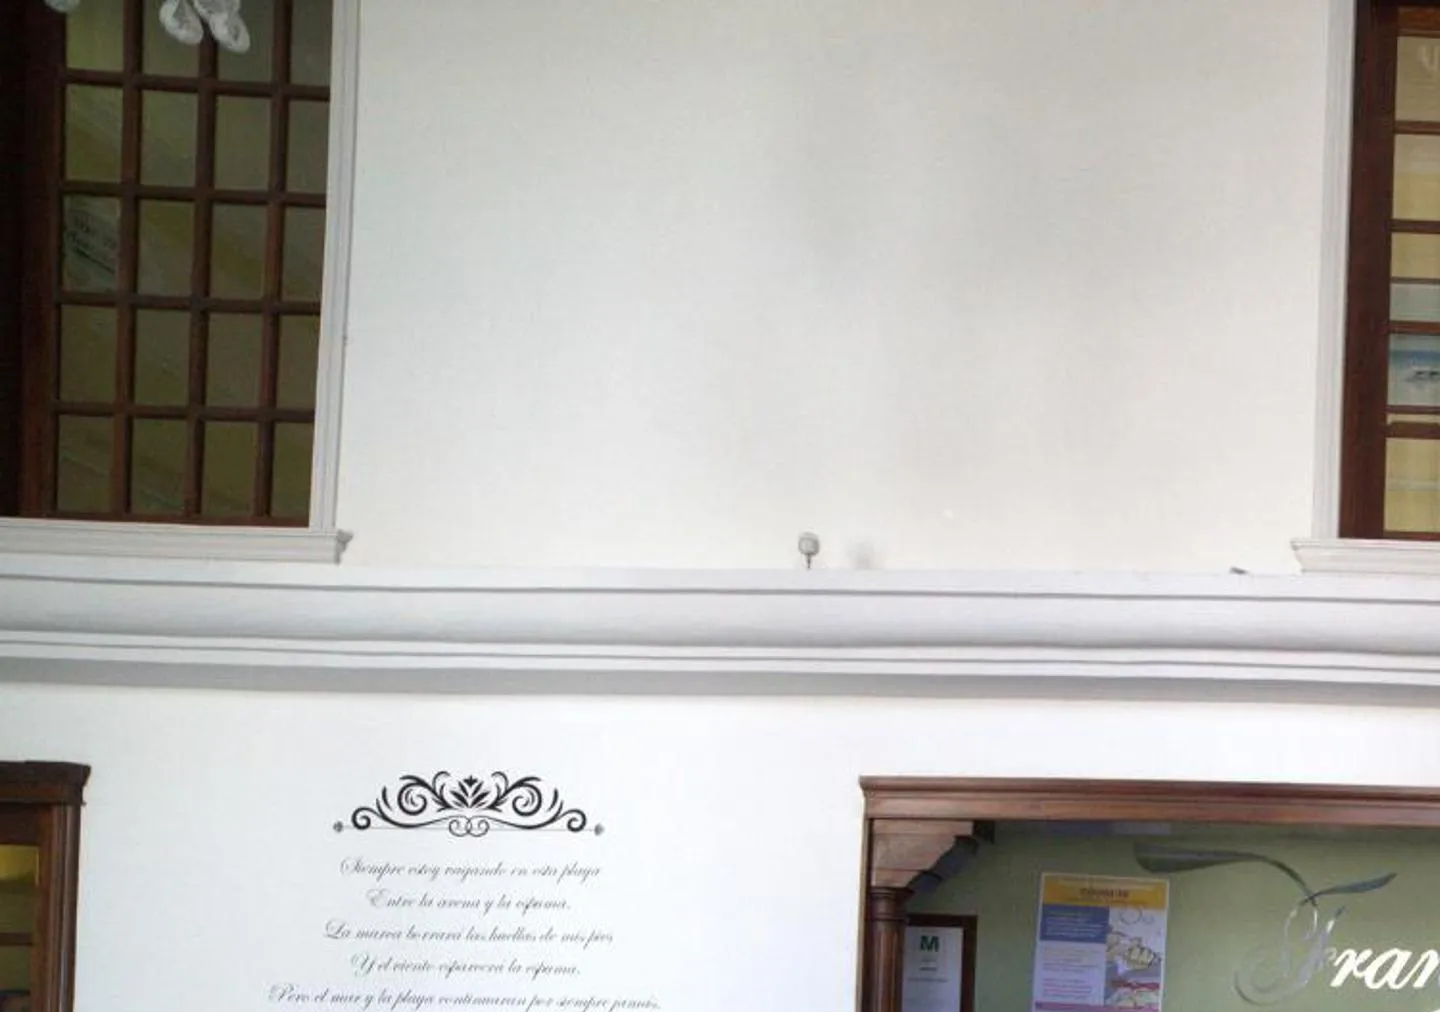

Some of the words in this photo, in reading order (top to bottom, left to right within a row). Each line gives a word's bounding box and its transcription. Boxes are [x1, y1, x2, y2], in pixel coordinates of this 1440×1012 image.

[418, 892, 434, 908] la
[497, 893, 512, 909] la
[323, 918, 351, 940] La
